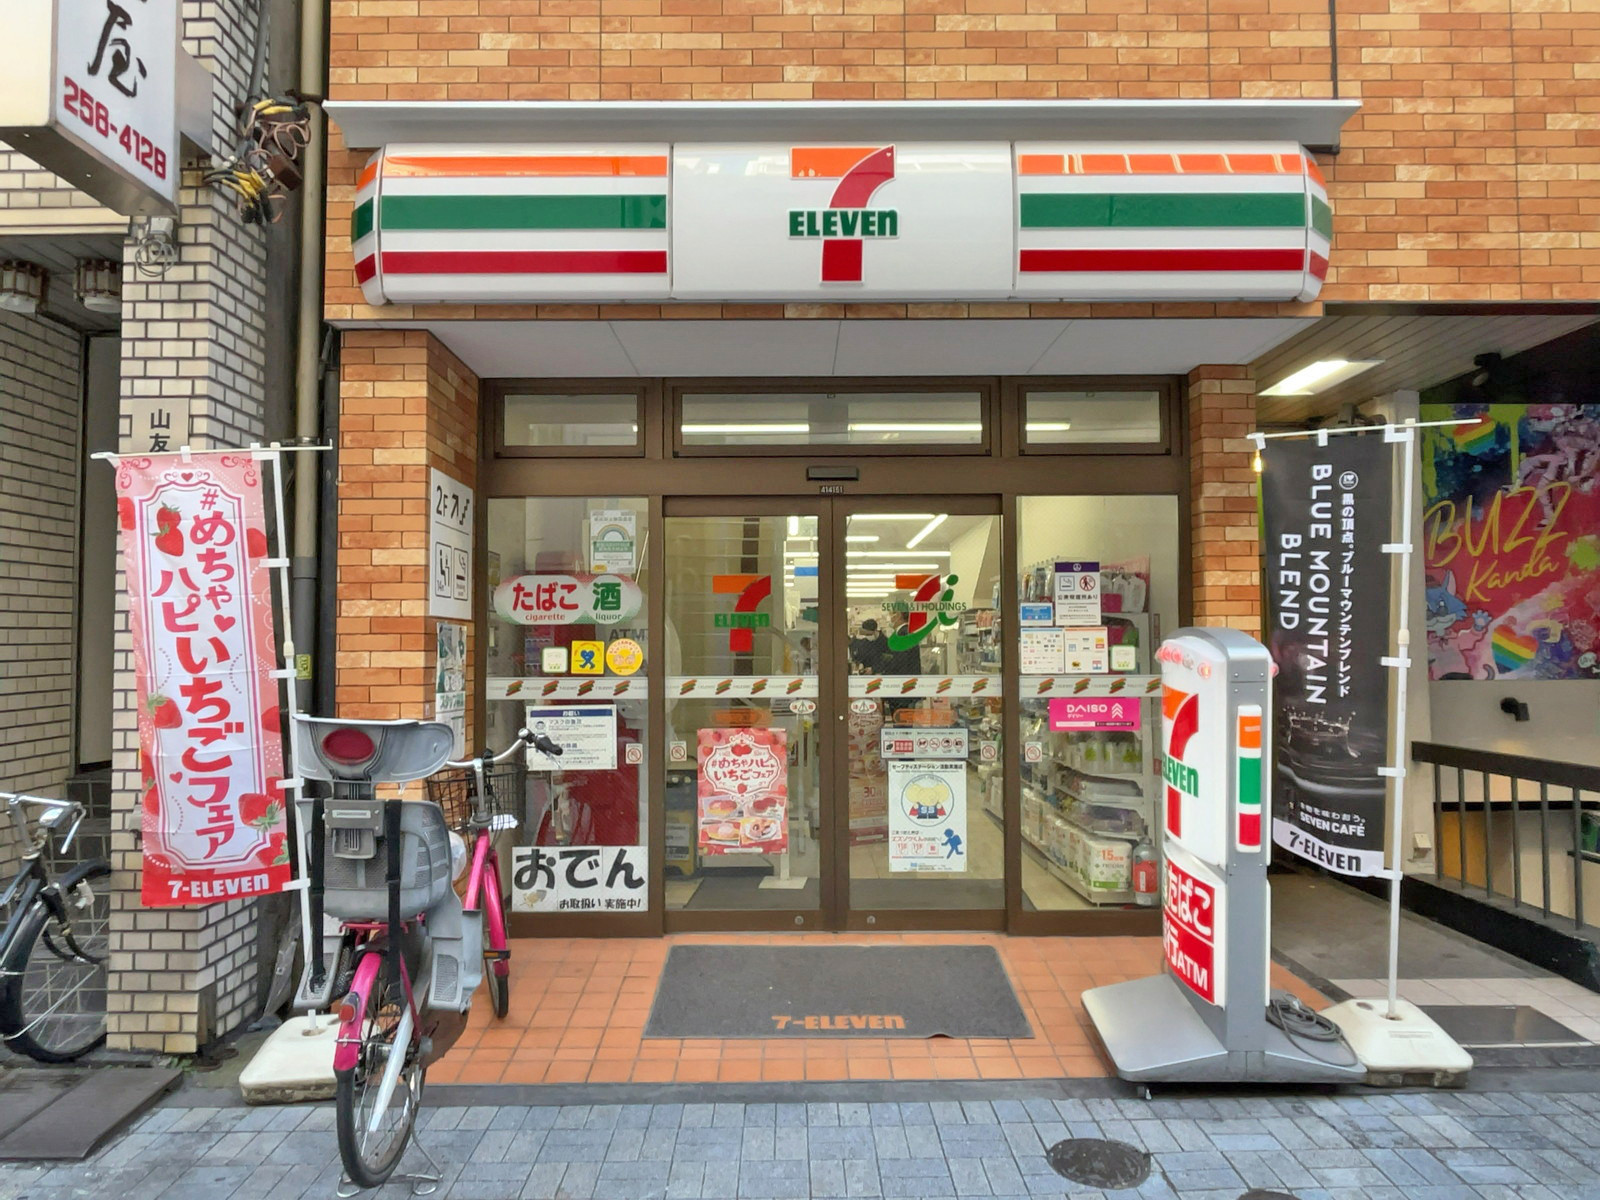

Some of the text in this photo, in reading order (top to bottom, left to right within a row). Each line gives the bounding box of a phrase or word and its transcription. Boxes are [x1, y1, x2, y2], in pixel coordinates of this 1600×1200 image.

[63, 76, 167, 181] 258-4128
[436, 484, 448, 517] 2F
[1423, 481, 1572, 567] BUZZ
[512, 582, 622, 611] たばこ 酒
[1278, 532, 1303, 630] BLEND
[1305, 463, 1333, 705] BLUE MOUNTAIN
[1465, 553, 1560, 602] Kanda
[525, 612, 622, 623] cigarette liquor
[922, 602, 967, 611] HOLDINGS
[1066, 704, 1108, 713] DAISO
[1300, 811, 1330, 832] SEVEN
[514, 848, 646, 890] おでん
[1168, 865, 1212, 937] たばこ
